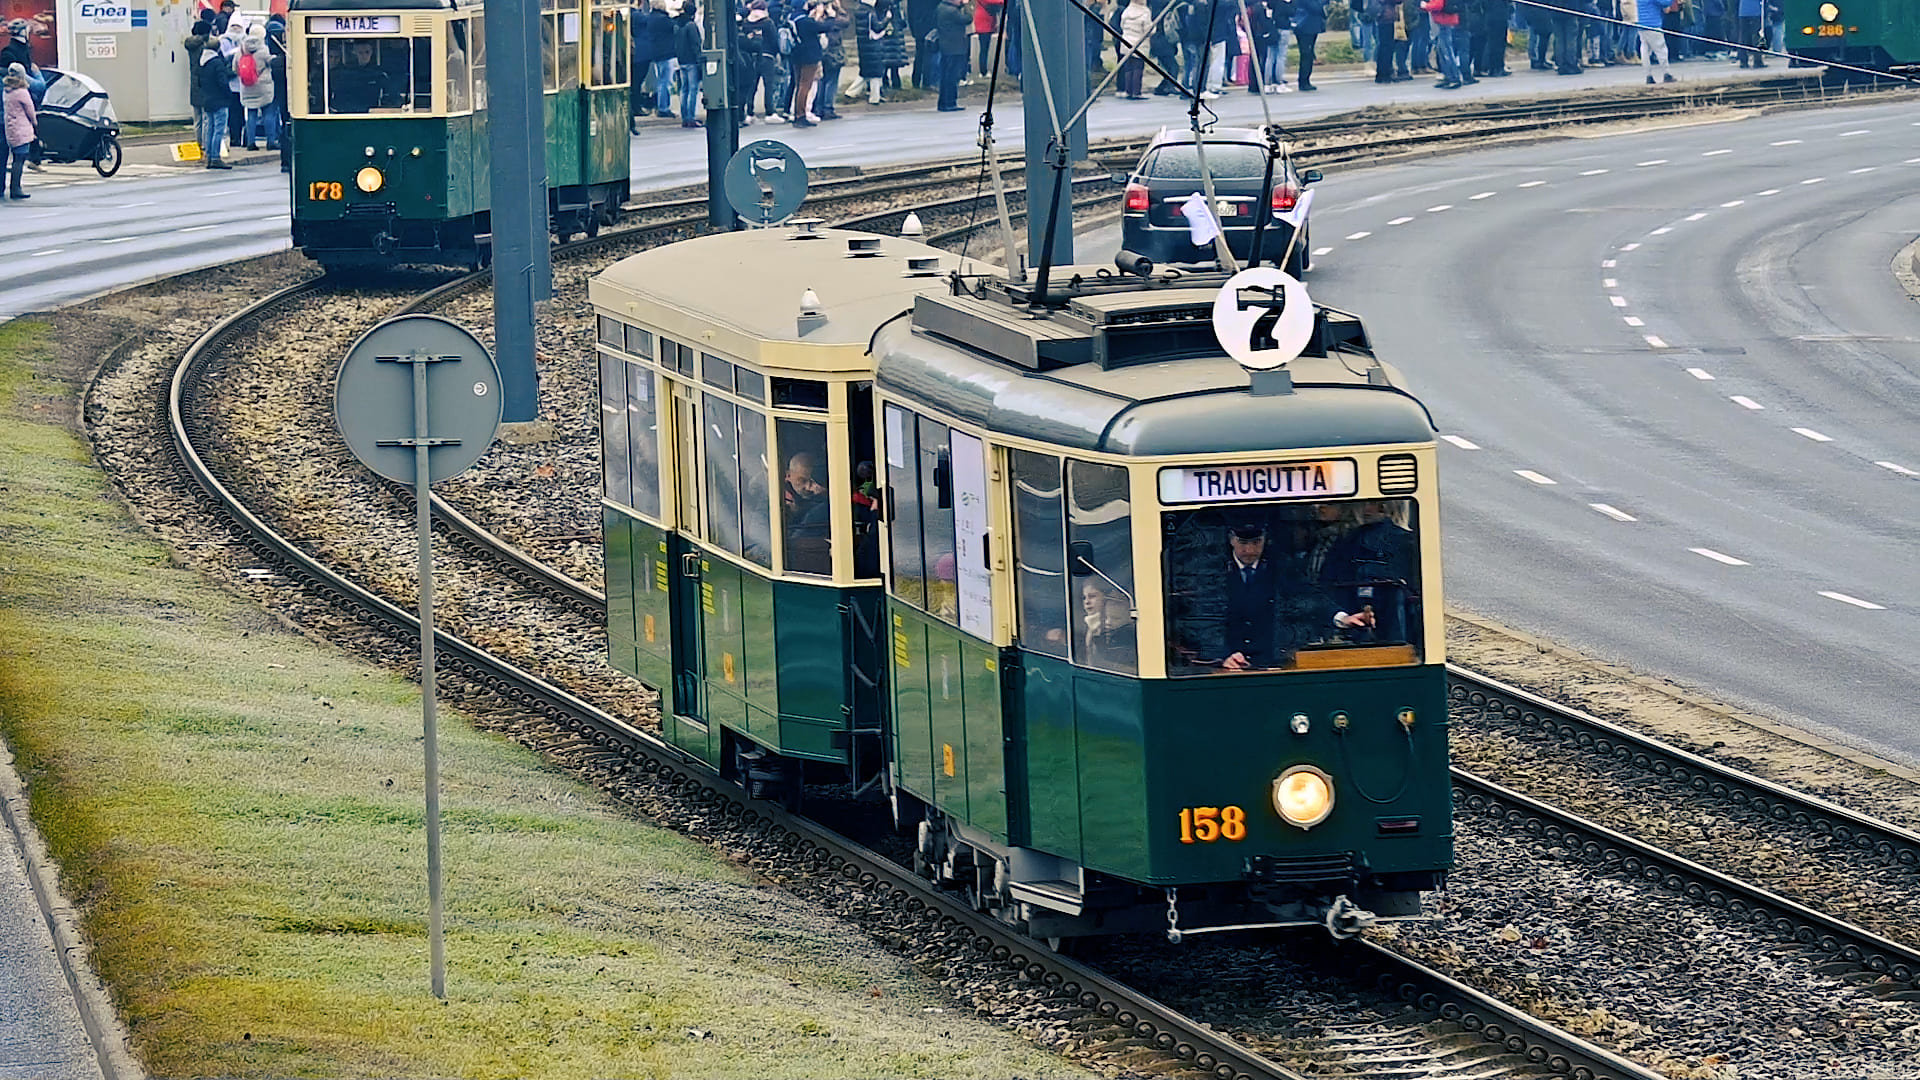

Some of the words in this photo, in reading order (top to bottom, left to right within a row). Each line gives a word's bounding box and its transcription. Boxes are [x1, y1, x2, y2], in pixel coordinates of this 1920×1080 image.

[81, 4, 127, 17] Enea
[335, 17, 379, 30] RATAJE
[1818, 24, 1844, 37] 286
[309, 181, 343, 201] 178
[1236, 284, 1286, 352] 7
[1193, 465, 1328, 497] TRAUGUTTA
[1178, 805, 1247, 844] 158
